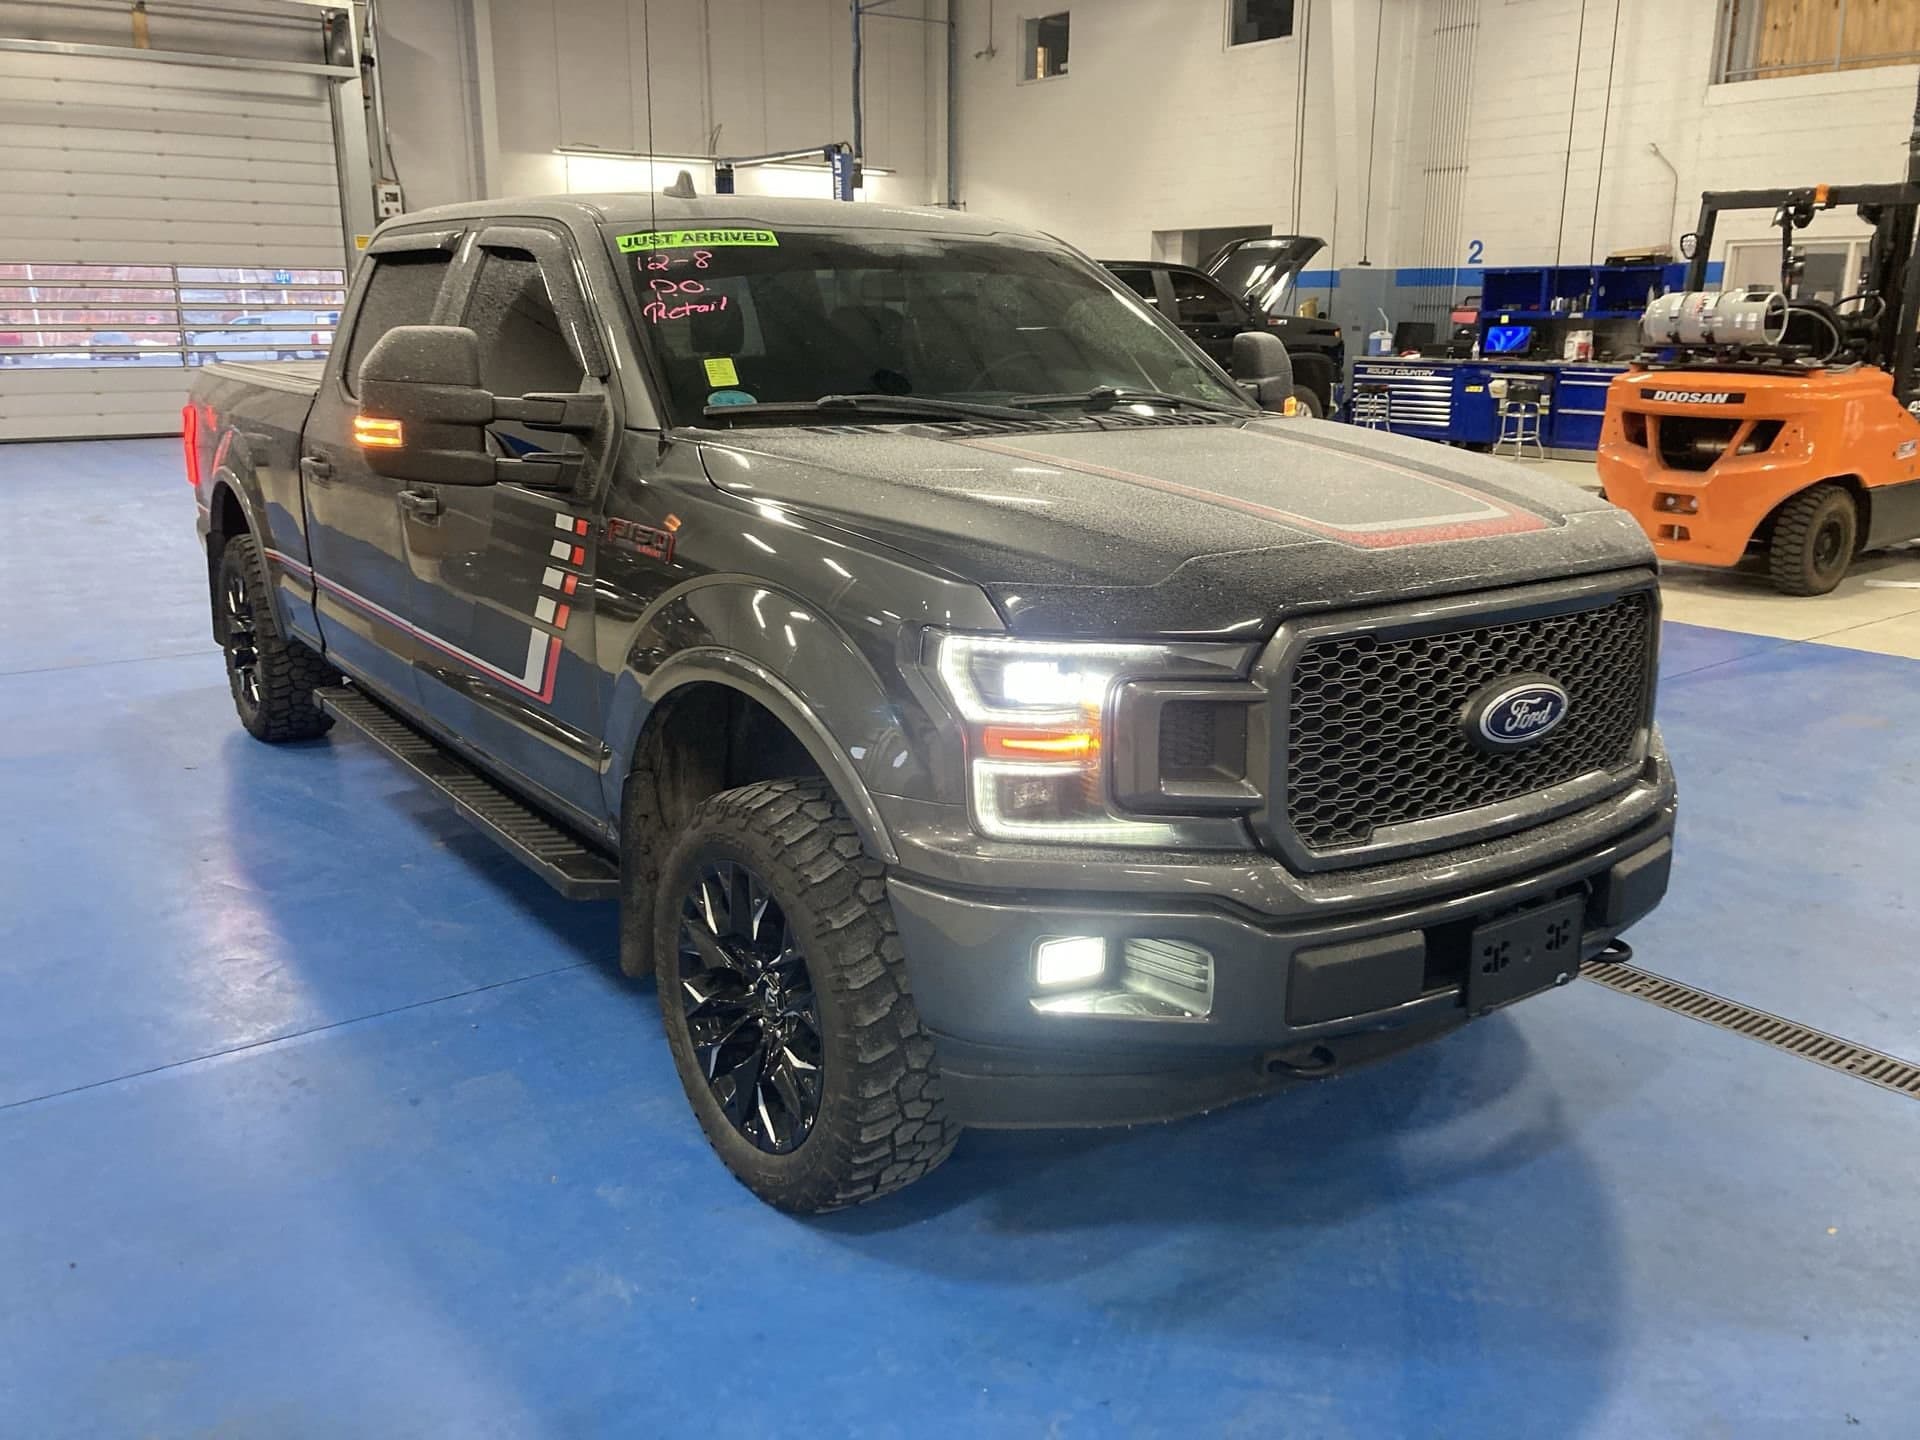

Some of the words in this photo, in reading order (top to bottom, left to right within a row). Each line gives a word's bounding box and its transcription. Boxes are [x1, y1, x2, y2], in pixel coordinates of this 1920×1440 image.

[622, 234, 673, 249] JUST
[681, 231, 770, 244] ARRIVED
[637, 250, 713, 271] 12-8
[1468, 240, 1483, 264] 2
[643, 296, 727, 324] Retail
[1366, 367, 1394, 375] ROUGH
[1394, 368, 1435, 377] COUNTRY
[1653, 390, 1730, 404] DOOSAN
[1504, 697, 1553, 732] Ford
